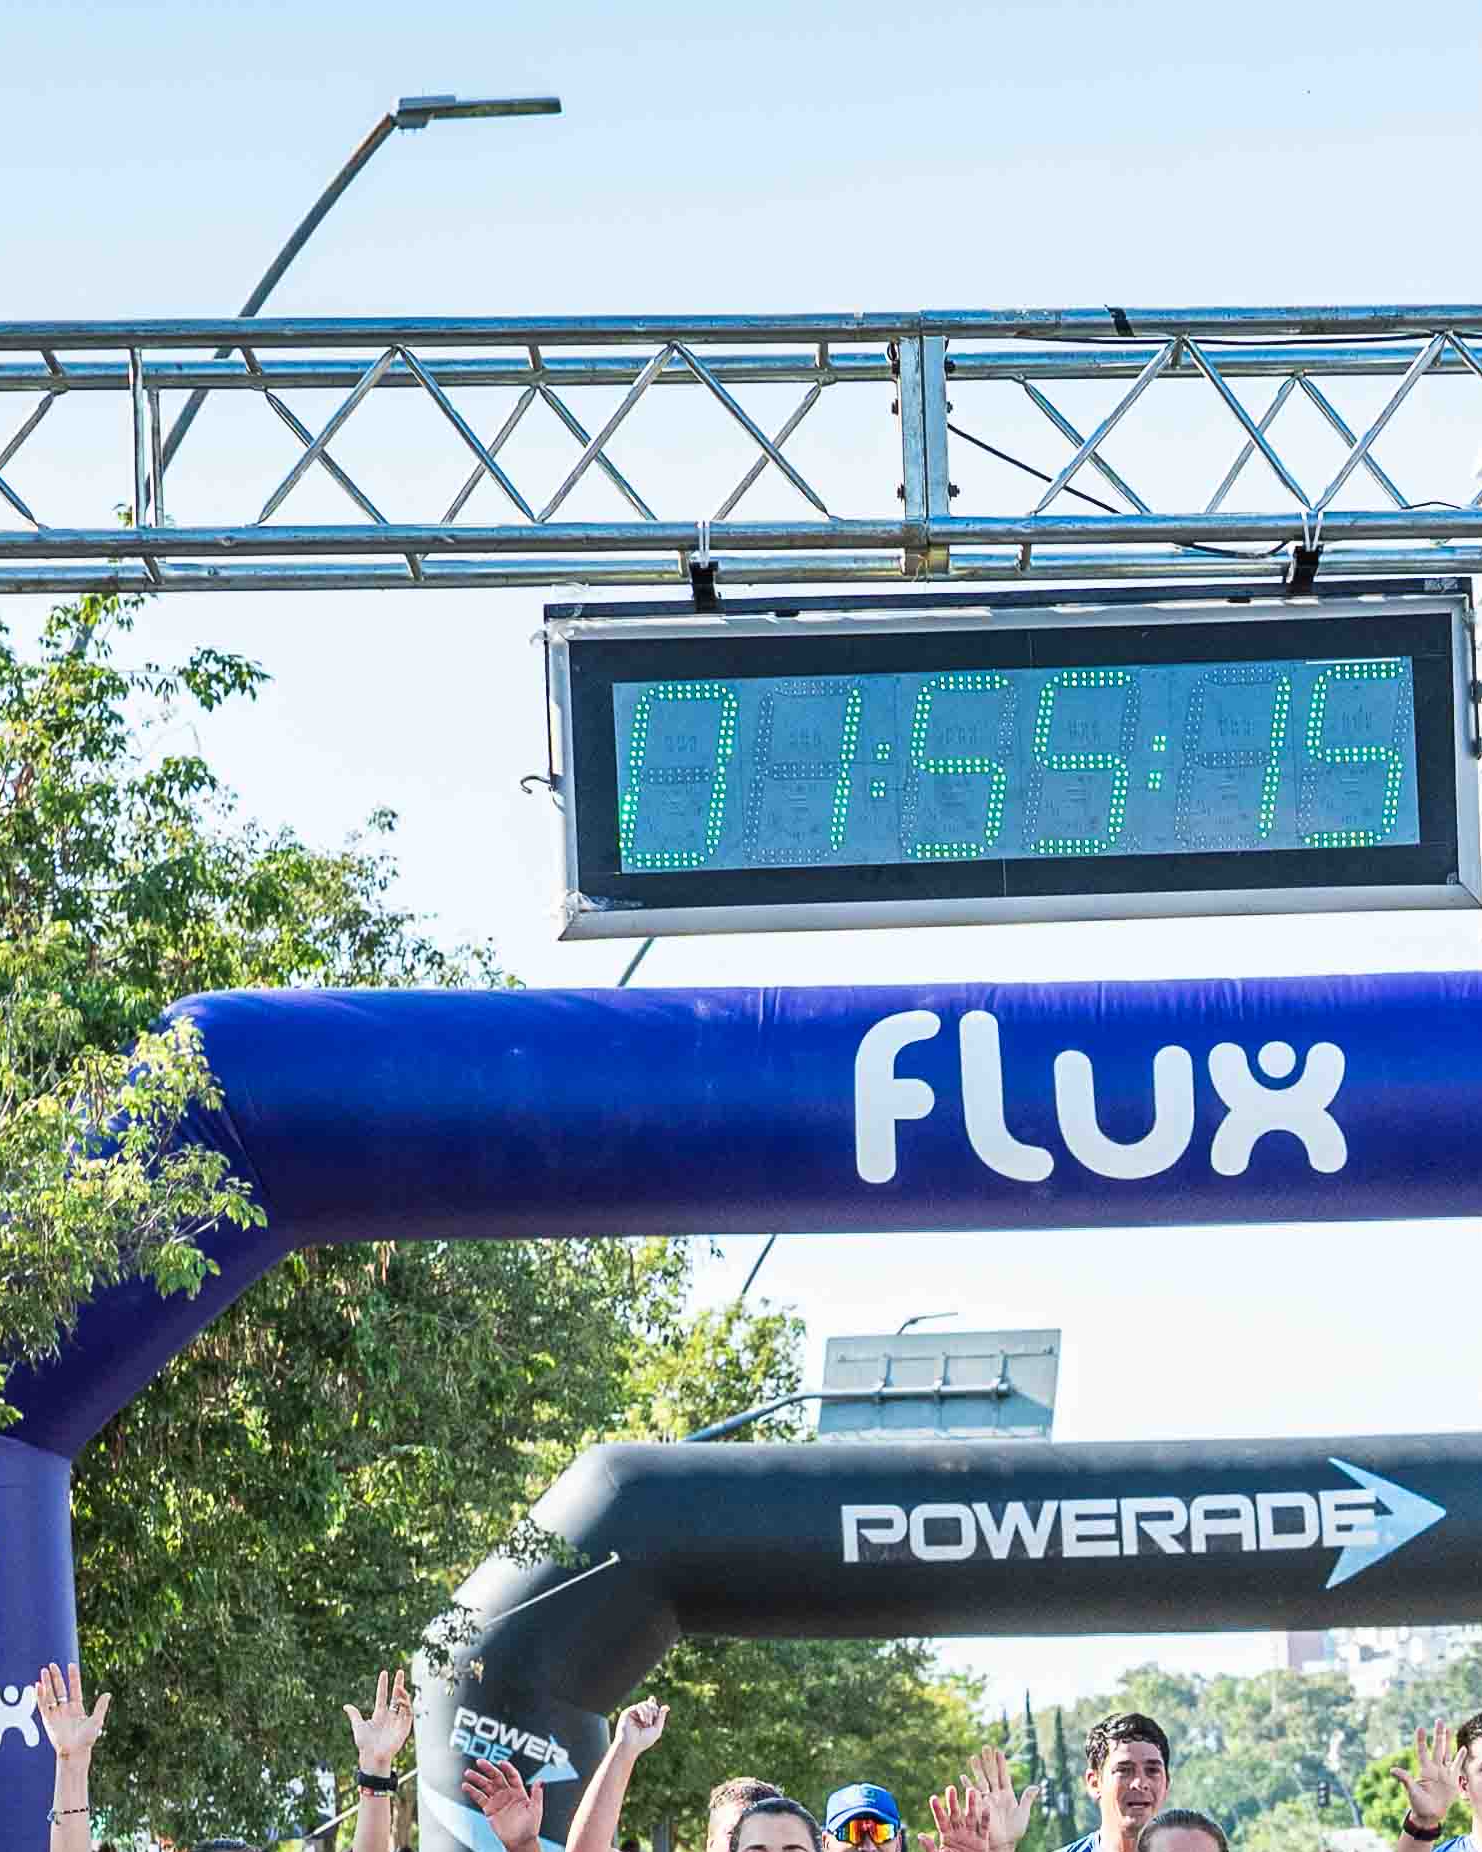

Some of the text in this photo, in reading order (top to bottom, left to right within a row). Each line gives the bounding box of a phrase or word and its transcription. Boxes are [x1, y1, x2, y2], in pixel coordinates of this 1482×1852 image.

[620, 658, 1403, 869] 01:55:15
[840, 1487, 1380, 1564] POWERADE
[449, 1727, 514, 1765] ADE
[453, 1706, 570, 1769] POWER
